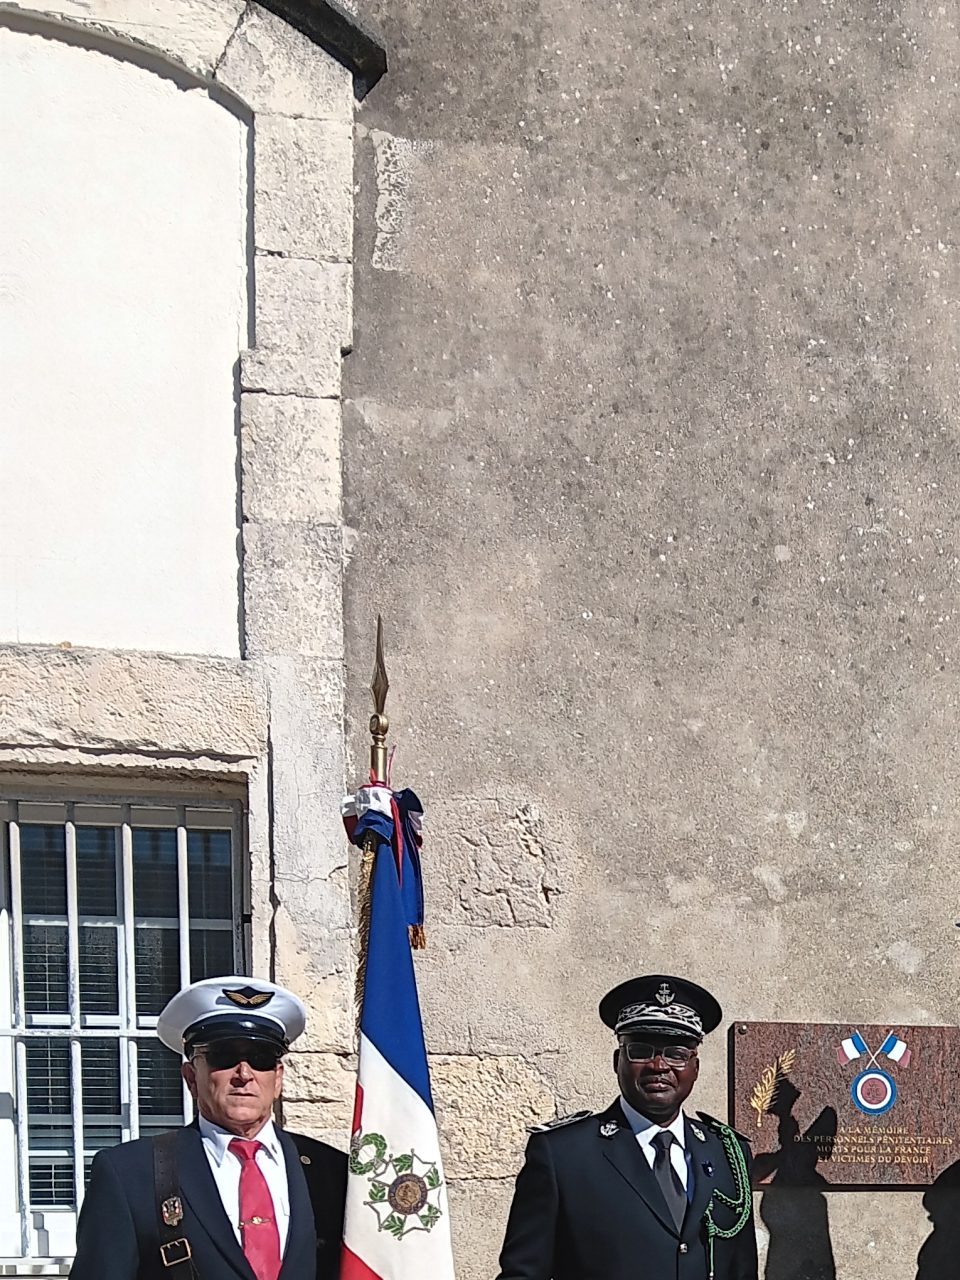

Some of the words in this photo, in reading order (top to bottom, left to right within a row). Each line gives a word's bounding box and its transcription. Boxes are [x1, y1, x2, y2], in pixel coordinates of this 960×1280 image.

[848, 1126, 861, 1134] LA
[864, 1124, 909, 1134] MÉMOIRE
[793, 1135, 811, 1143] DES
[814, 1135, 874, 1144] PERSONNELS
[877, 1135, 953, 1145] PÉNITENTIAIRES
[816, 1145, 848, 1154] MORTS
[851, 1145, 876, 1154] POUR
[880, 1146, 892, 1154] LA
[895, 1146, 931, 1154] FRANCE
[818, 1155, 828, 1163] ET
[831, 1155, 875, 1163] VICTIMES
[895, 1155, 929, 1163] DEVOIR
